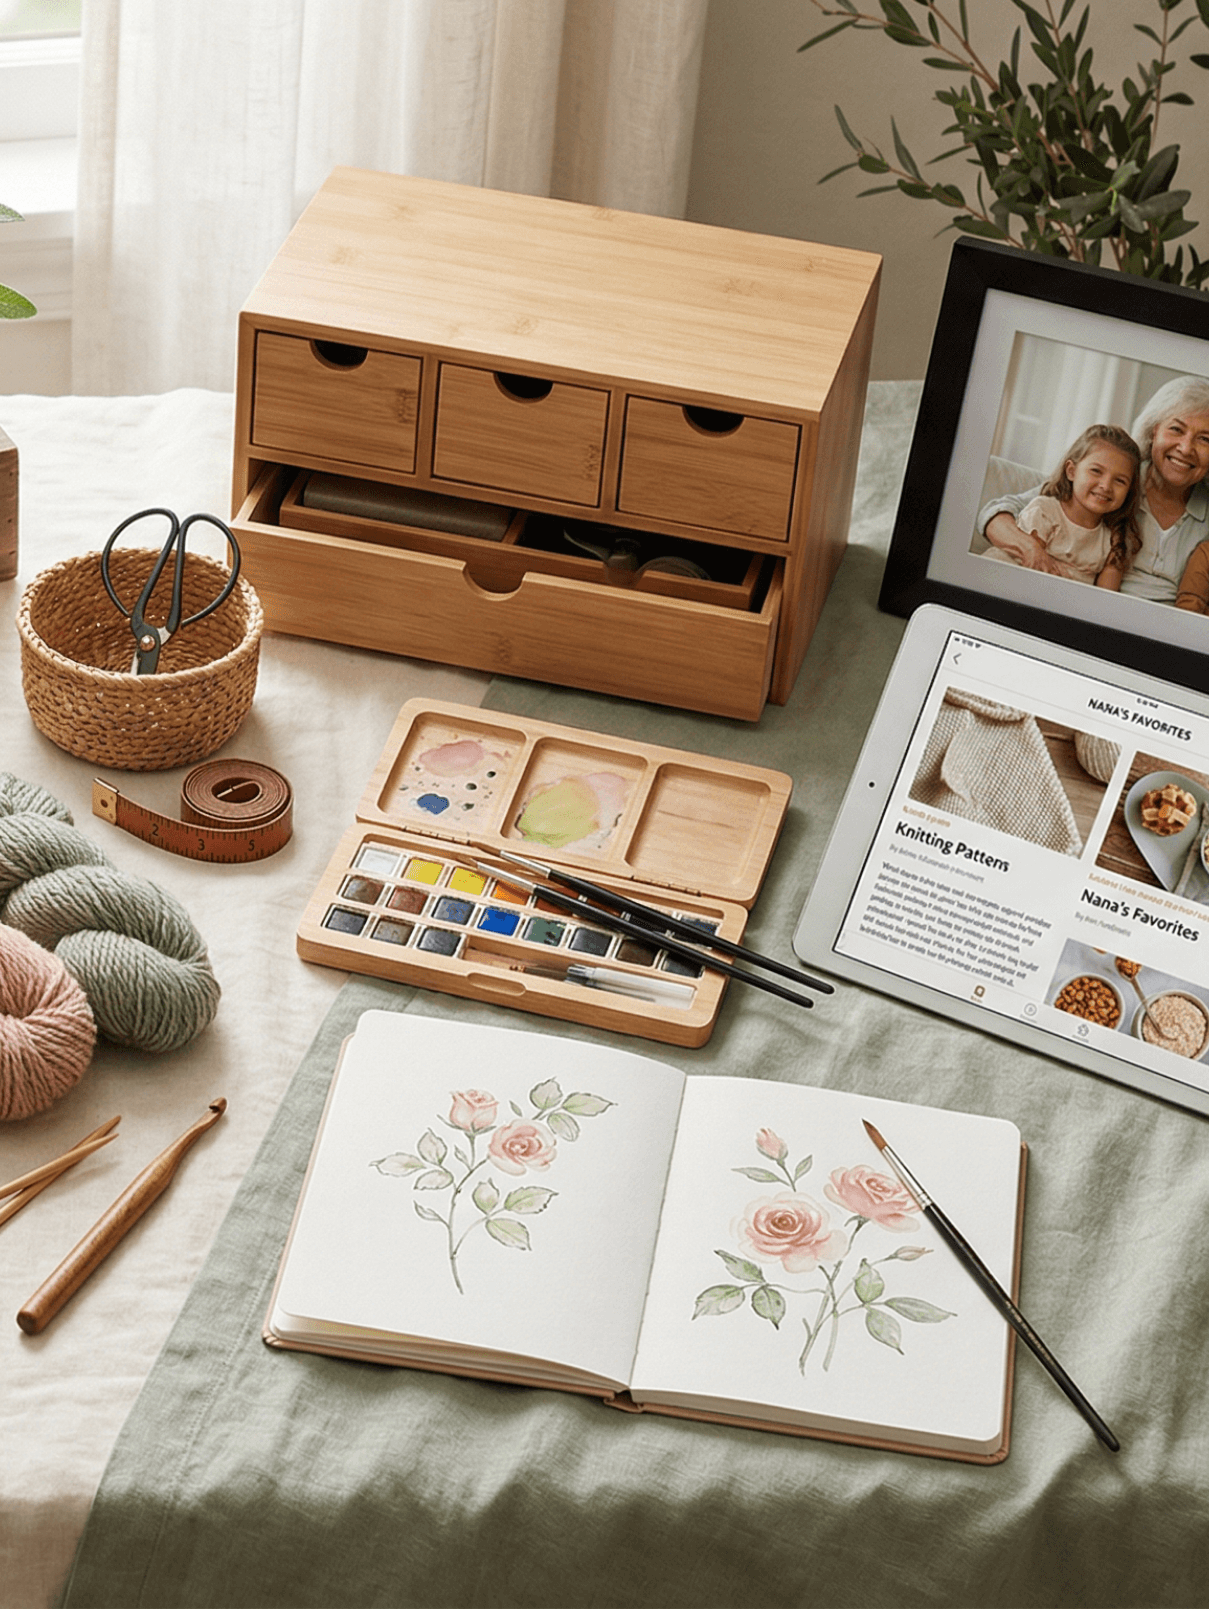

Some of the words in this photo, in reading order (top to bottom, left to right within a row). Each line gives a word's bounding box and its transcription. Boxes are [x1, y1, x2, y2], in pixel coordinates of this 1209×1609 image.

[1088, 698, 1129, 720] NANA'S
[151, 823, 159, 837] 2
[197, 838, 205, 851] 3
[248, 839, 255, 851] 5
[895, 821, 954, 855] Knitting
[1081, 888, 1131, 918] Nana's
[1132, 907, 1200, 941] Favorites
